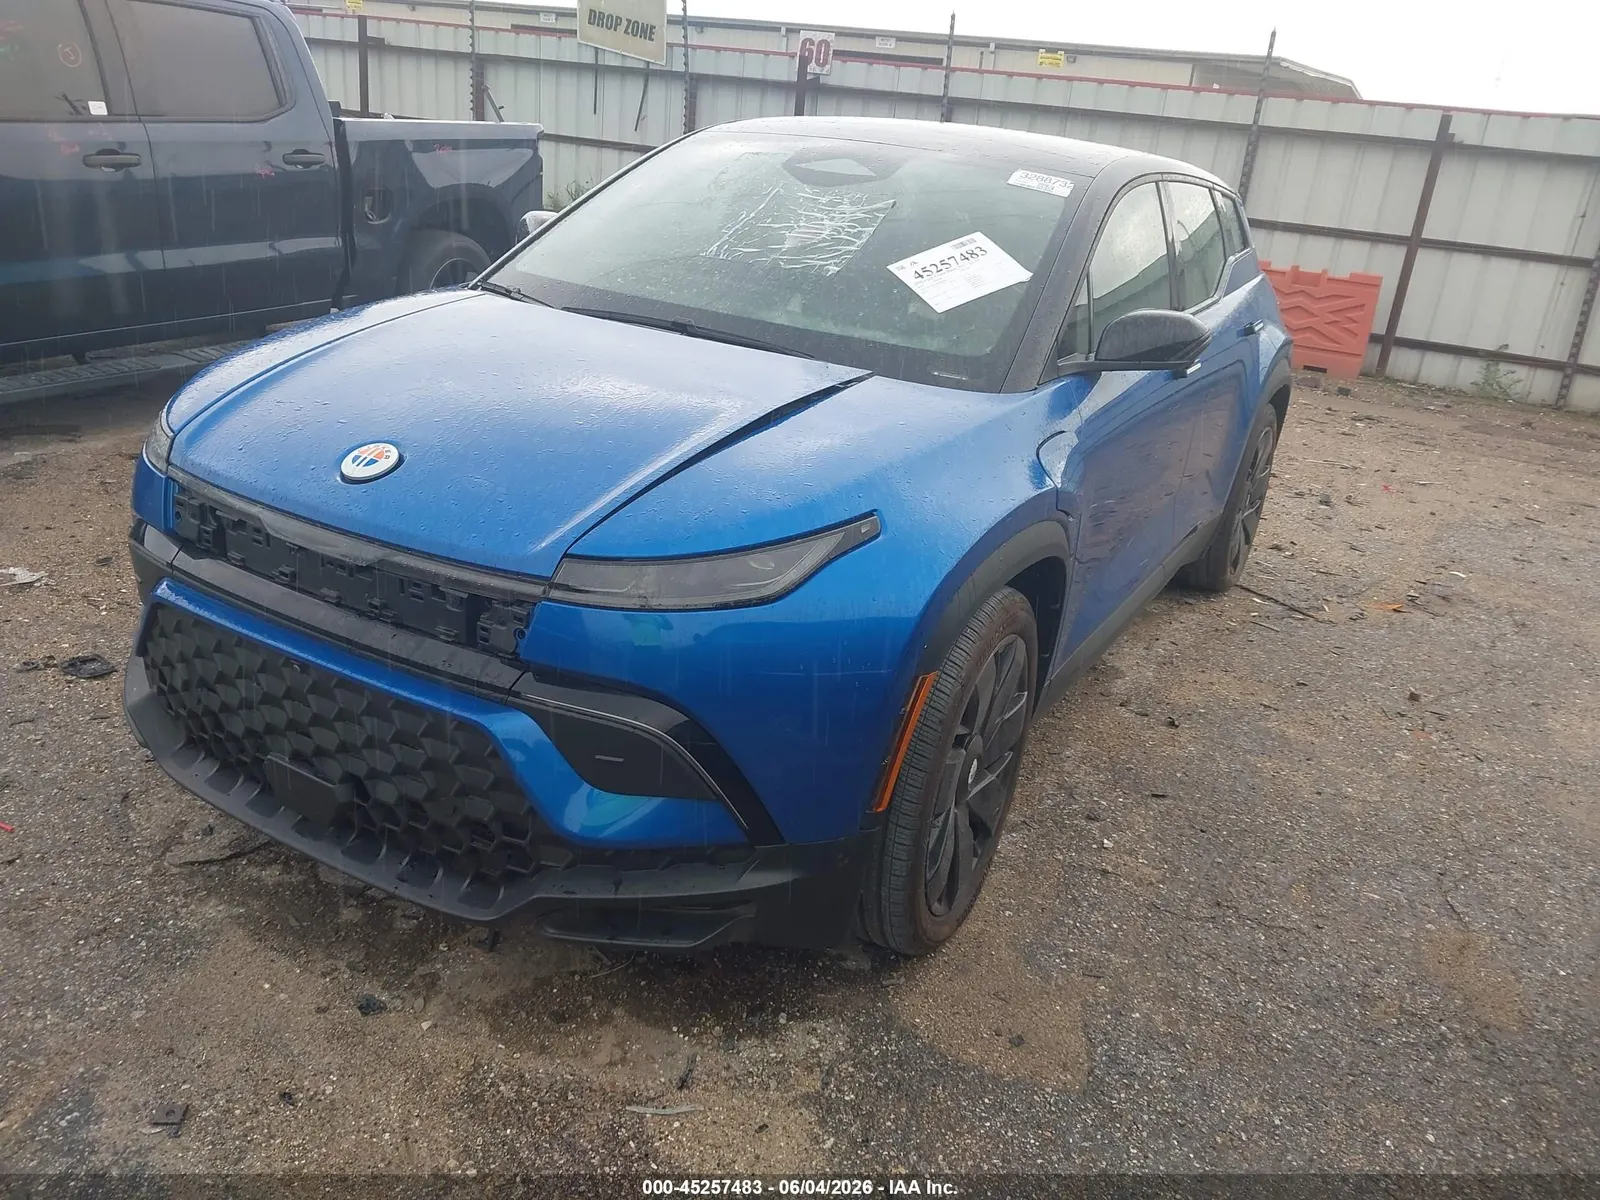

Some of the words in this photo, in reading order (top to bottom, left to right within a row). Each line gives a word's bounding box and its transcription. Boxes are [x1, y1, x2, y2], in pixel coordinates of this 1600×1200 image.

[587, 8, 623, 32] DROP
[623, 18, 657, 42] ZONE
[800, 37, 831, 68] 60
[913, 246, 988, 280] 45257483
